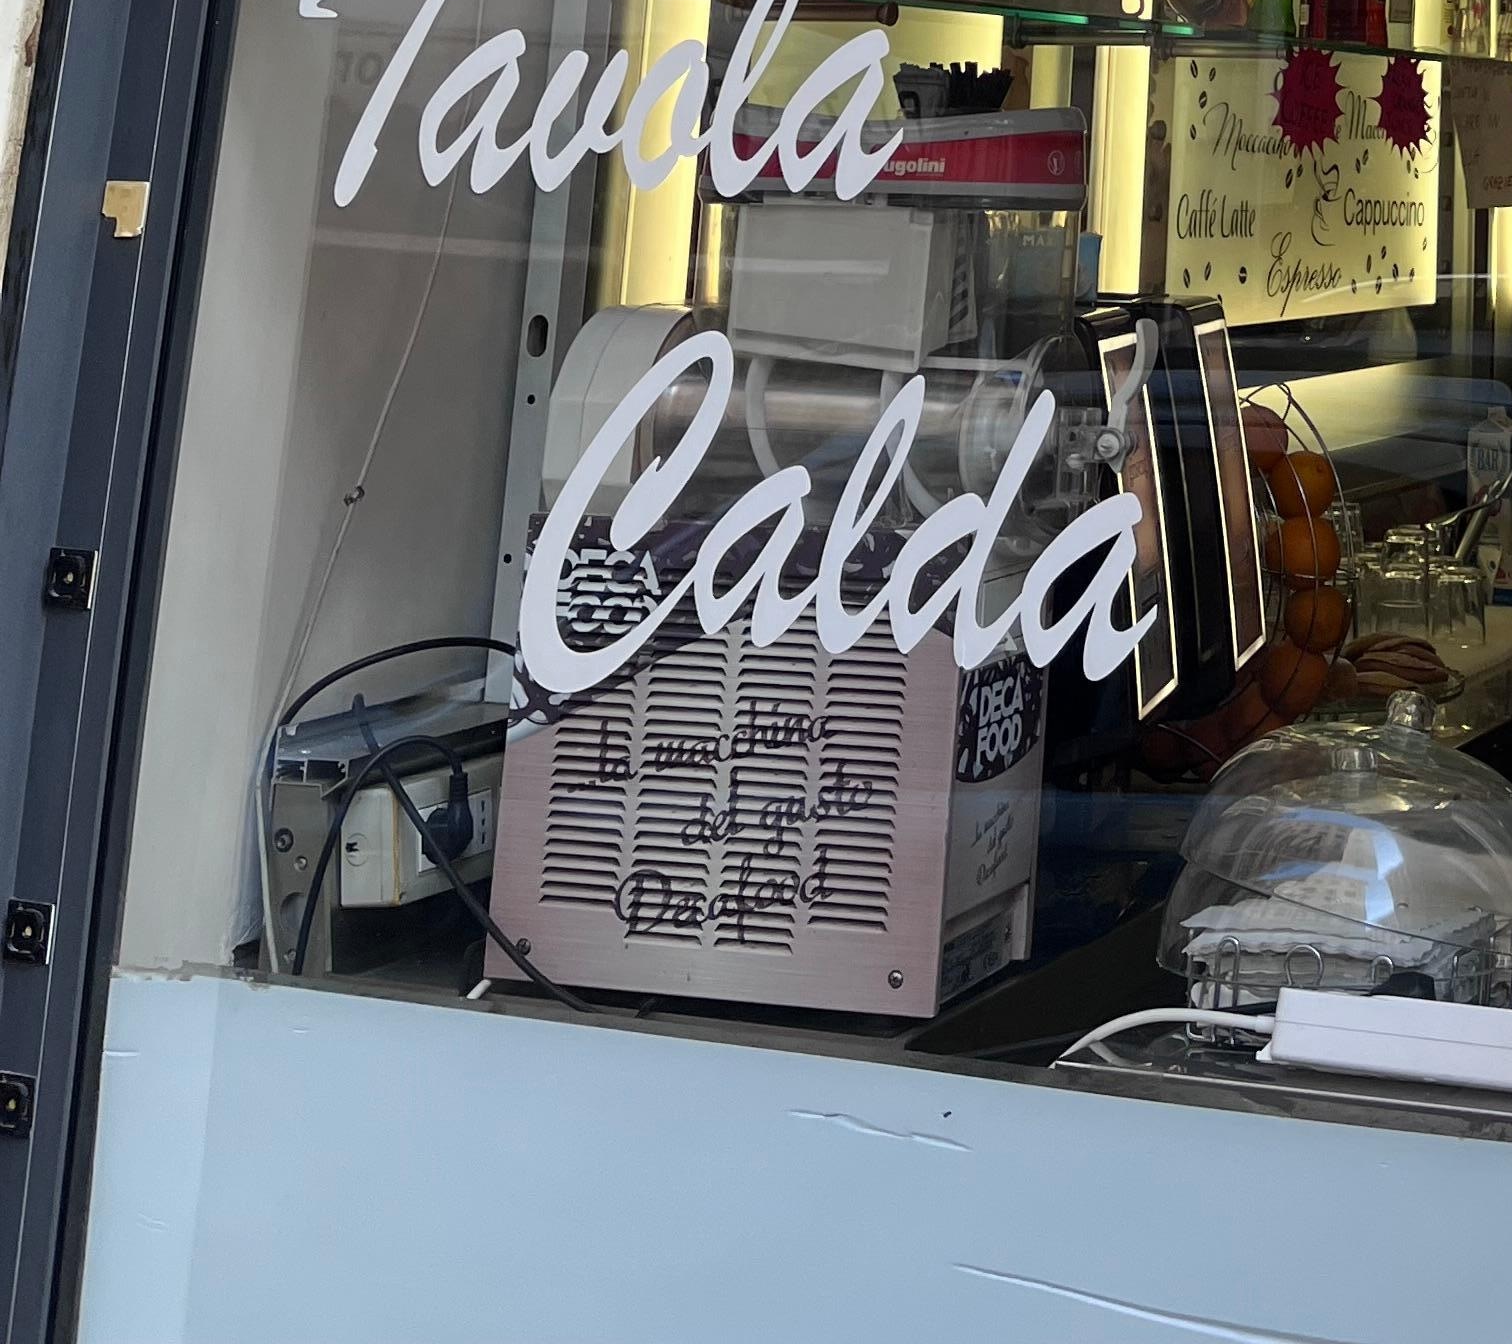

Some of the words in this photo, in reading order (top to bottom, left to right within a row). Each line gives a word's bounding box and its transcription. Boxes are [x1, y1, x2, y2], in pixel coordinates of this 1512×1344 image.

[1220, 194, 1256, 239] Latte
[1343, 188, 1425, 236] Cappuccino
[1266, 231, 1343, 318] Espresso
[1478, 449, 1499, 472] BAR
[519, 329, 1159, 694] Calda
[977, 671, 1024, 727] DECA
[975, 713, 1023, 764] FOOD
[680, 767, 744, 846] del
[758, 761, 873, 857] gusto
